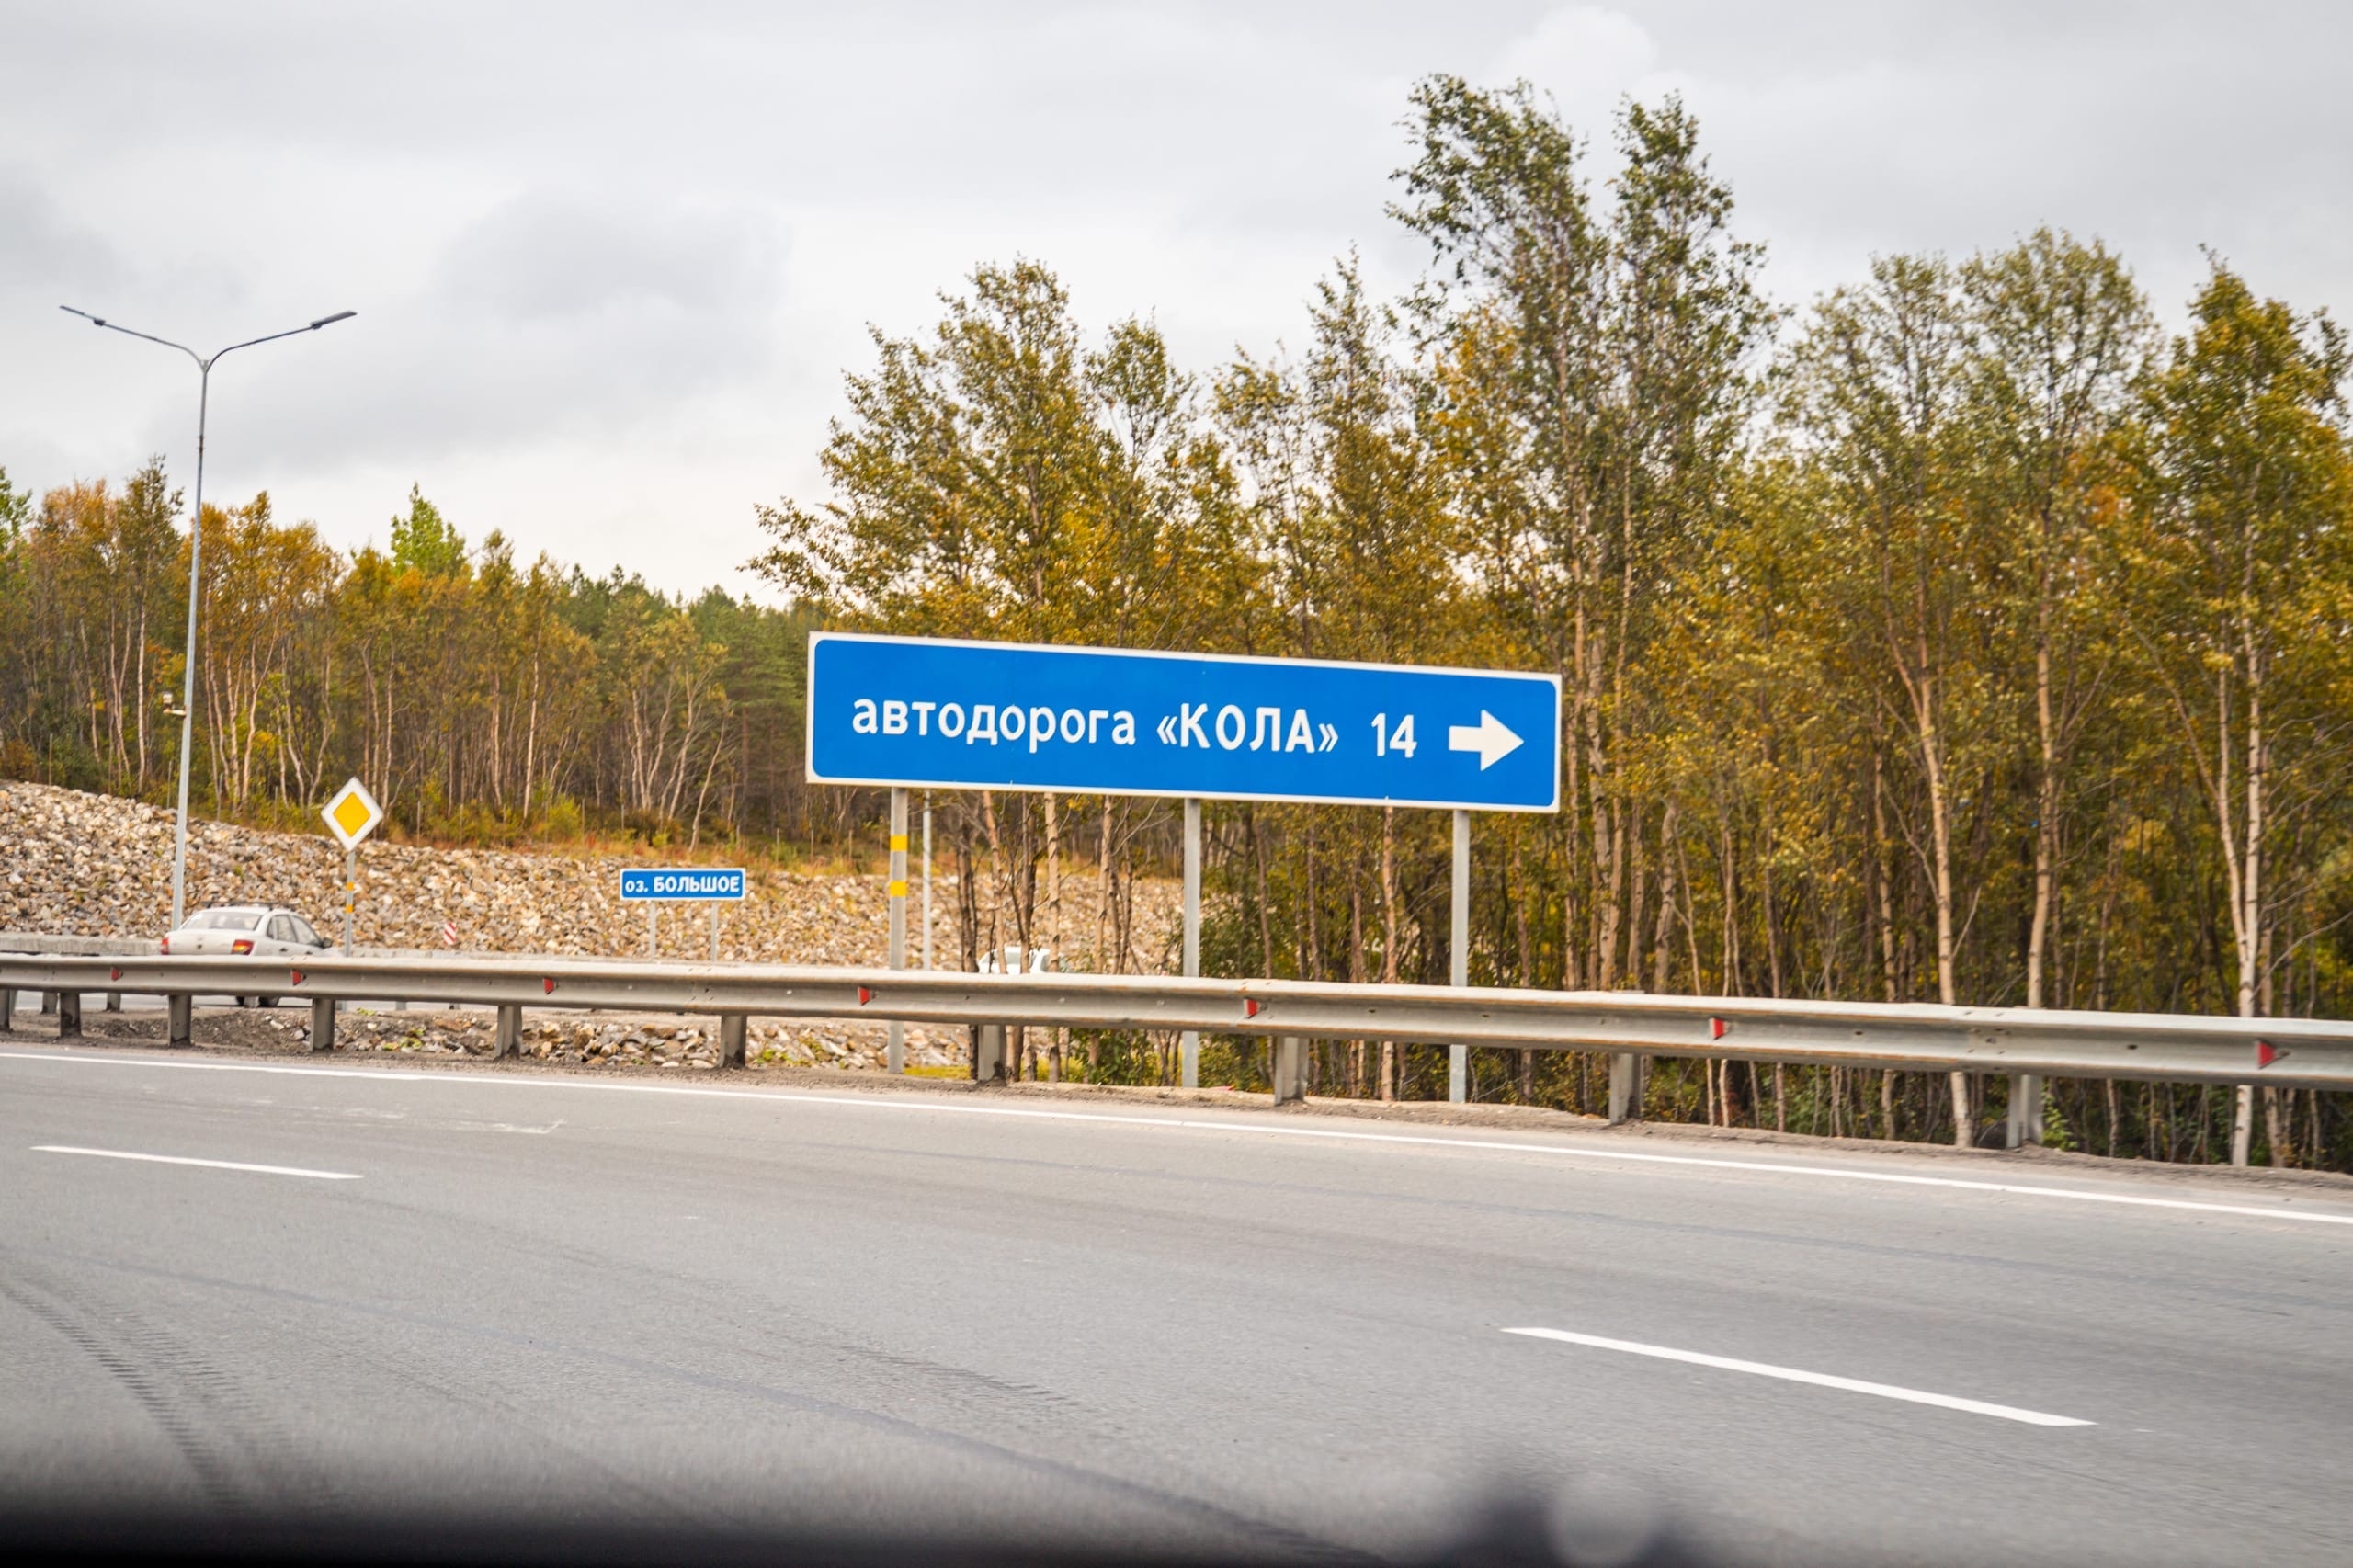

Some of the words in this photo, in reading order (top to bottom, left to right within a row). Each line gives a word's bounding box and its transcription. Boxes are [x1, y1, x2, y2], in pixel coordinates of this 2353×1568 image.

[851, 699, 1136, 754] автодорога
[1156, 702, 1339, 754] «КОЛА»
[1370, 712, 1418, 759] 14
[624, 880, 649, 893] оз.
[654, 876, 740, 892] БОЛЬШОЕ
